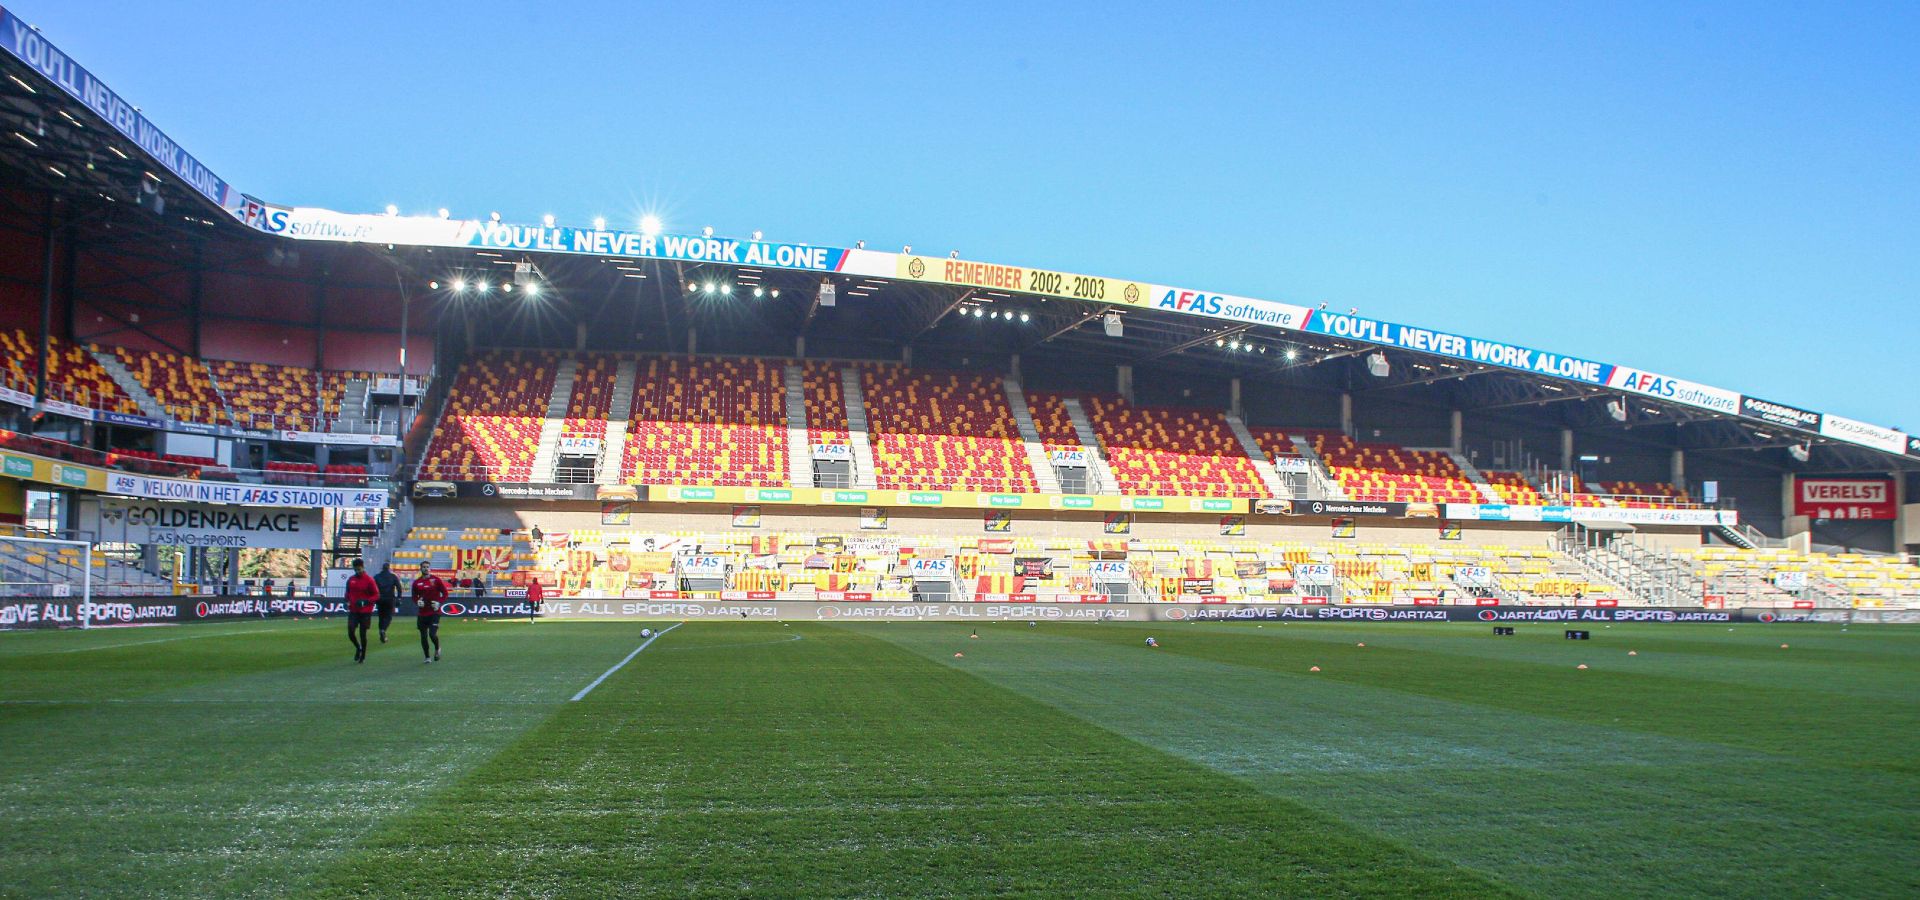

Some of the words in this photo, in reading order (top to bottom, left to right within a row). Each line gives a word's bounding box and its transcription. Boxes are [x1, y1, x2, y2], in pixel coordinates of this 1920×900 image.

[12, 18, 81, 95] YOU'LL
[84, 74, 136, 138] NEVER
[138, 117, 179, 165] WORK
[180, 153, 220, 201] ALONE
[476, 223, 567, 252] YOU'LL
[574, 230, 657, 257] NEVER
[664, 235, 740, 263] WORK
[744, 242, 828, 270] ALONE
[944, 260, 1023, 290] REMEMBER
[1030, 270, 1062, 294] 2002
[1074, 275, 1106, 300] 2003
[1159, 287, 1225, 315] AFAS
[1223, 302, 1293, 326] software
[1320, 312, 1396, 344] YOU'LL
[1399, 326, 1467, 357] NEVER
[1470, 339, 1532, 370] WORK
[1534, 353, 1602, 383] ALONE
[1623, 371, 1678, 397] AFAS
[1676, 386, 1737, 411] software
[565, 437, 595, 448] AFAS
[816, 444, 846, 454] AFAS
[1056, 451, 1084, 461] AFAS
[1279, 458, 1306, 467] AFAS
[115, 477, 135, 488] AFAS
[142, 480, 194, 498] WELKOM
[197, 486, 210, 500] IN
[214, 487, 241, 501] HET
[242, 489, 279, 503] AFAS
[282, 492, 344, 506] STADION
[353, 493, 383, 502] AFAS
[1807, 485, 1882, 499] VERELST
[126, 506, 301, 533] GOLDENPALACE
[1659, 513, 1681, 521] AFAS
[202, 534, 247, 547] SPORTS
[686, 557, 719, 567] AFAS
[914, 560, 947, 570] AFAS
[1095, 562, 1125, 572] AFAS
[1300, 565, 1329, 575] AFAS
[1460, 567, 1487, 577] AFAS
[1534, 582, 1559, 594] OUDE
[1563, 582, 1589, 594] POST
[42, 602, 73, 622] ALL
[135, 605, 177, 619] JARTAZI
[254, 600, 269, 613] ALL
[579, 603, 615, 615] ALL
[622, 603, 703, 616] SPORTS
[707, 606, 777, 616] JARTAZI
[946, 605, 980, 617] ALL
[986, 606, 1060, 618] SPORTS
[1066, 609, 1129, 618] JARTAZI
[1283, 607, 1313, 618] ALL
[1319, 608, 1385, 619] SPORTS
[1389, 610, 1447, 620] JARTAZI
[1582, 609, 1610, 620] ALL
[1615, 610, 1674, 621] SPORTS
[1677, 613, 1729, 621] JARTAZI
